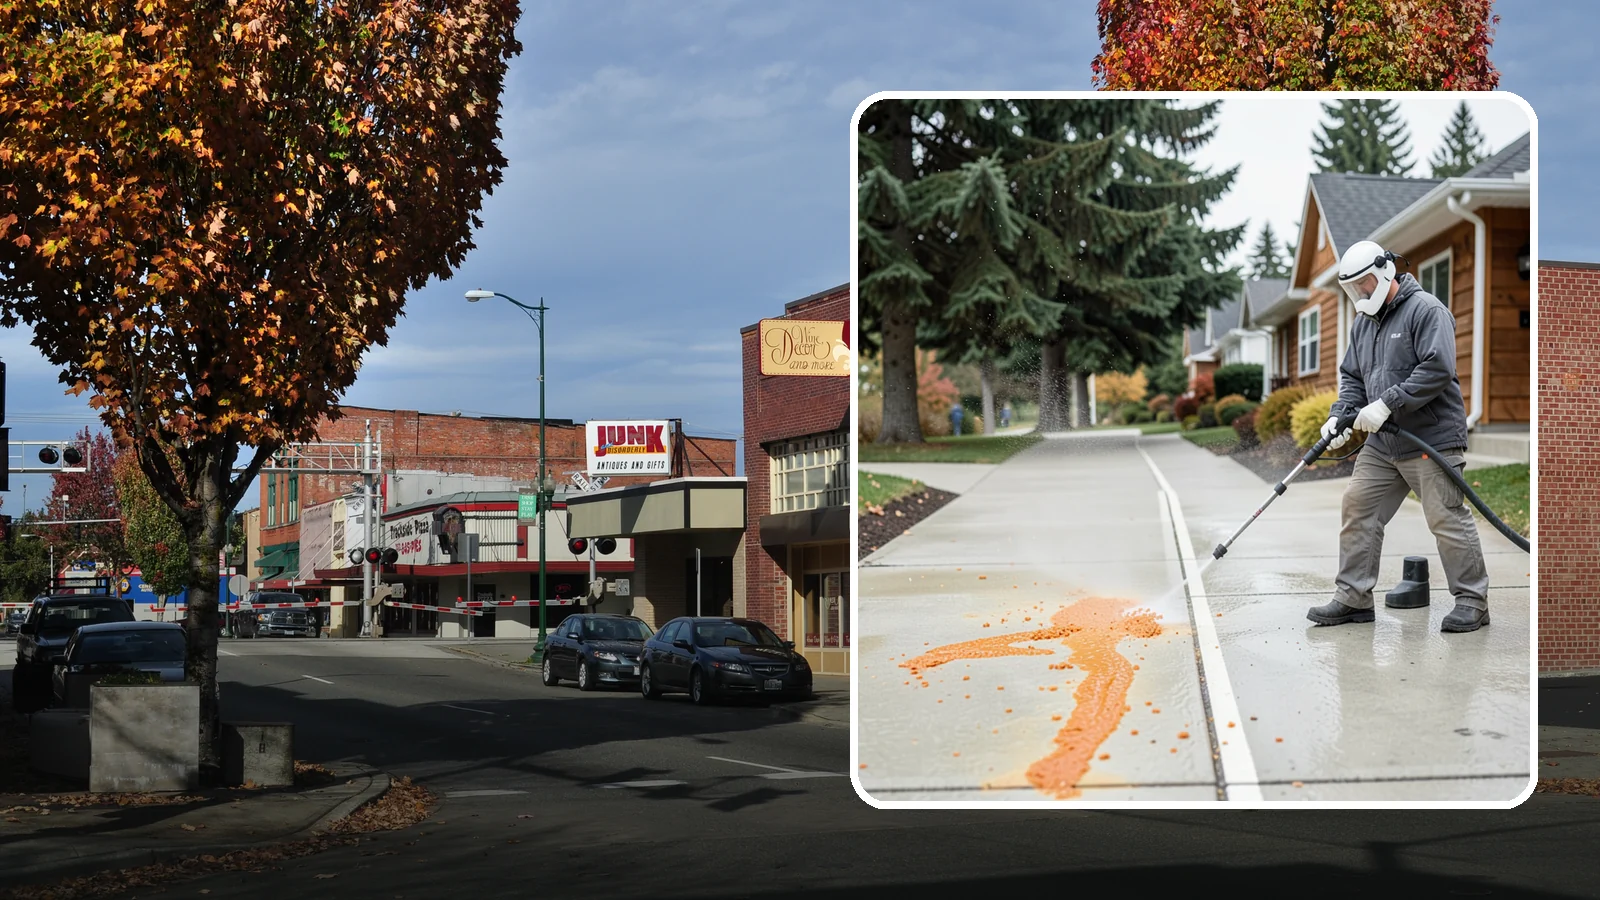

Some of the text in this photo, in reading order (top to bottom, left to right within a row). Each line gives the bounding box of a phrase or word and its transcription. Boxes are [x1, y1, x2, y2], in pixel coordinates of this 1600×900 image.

[595, 425, 666, 457] JUNK
[607, 446, 646, 454] DISORDERLY
[597, 460, 666, 470] ANTIQUES AND GIFTS
[414, 519, 429, 535] Pizza
